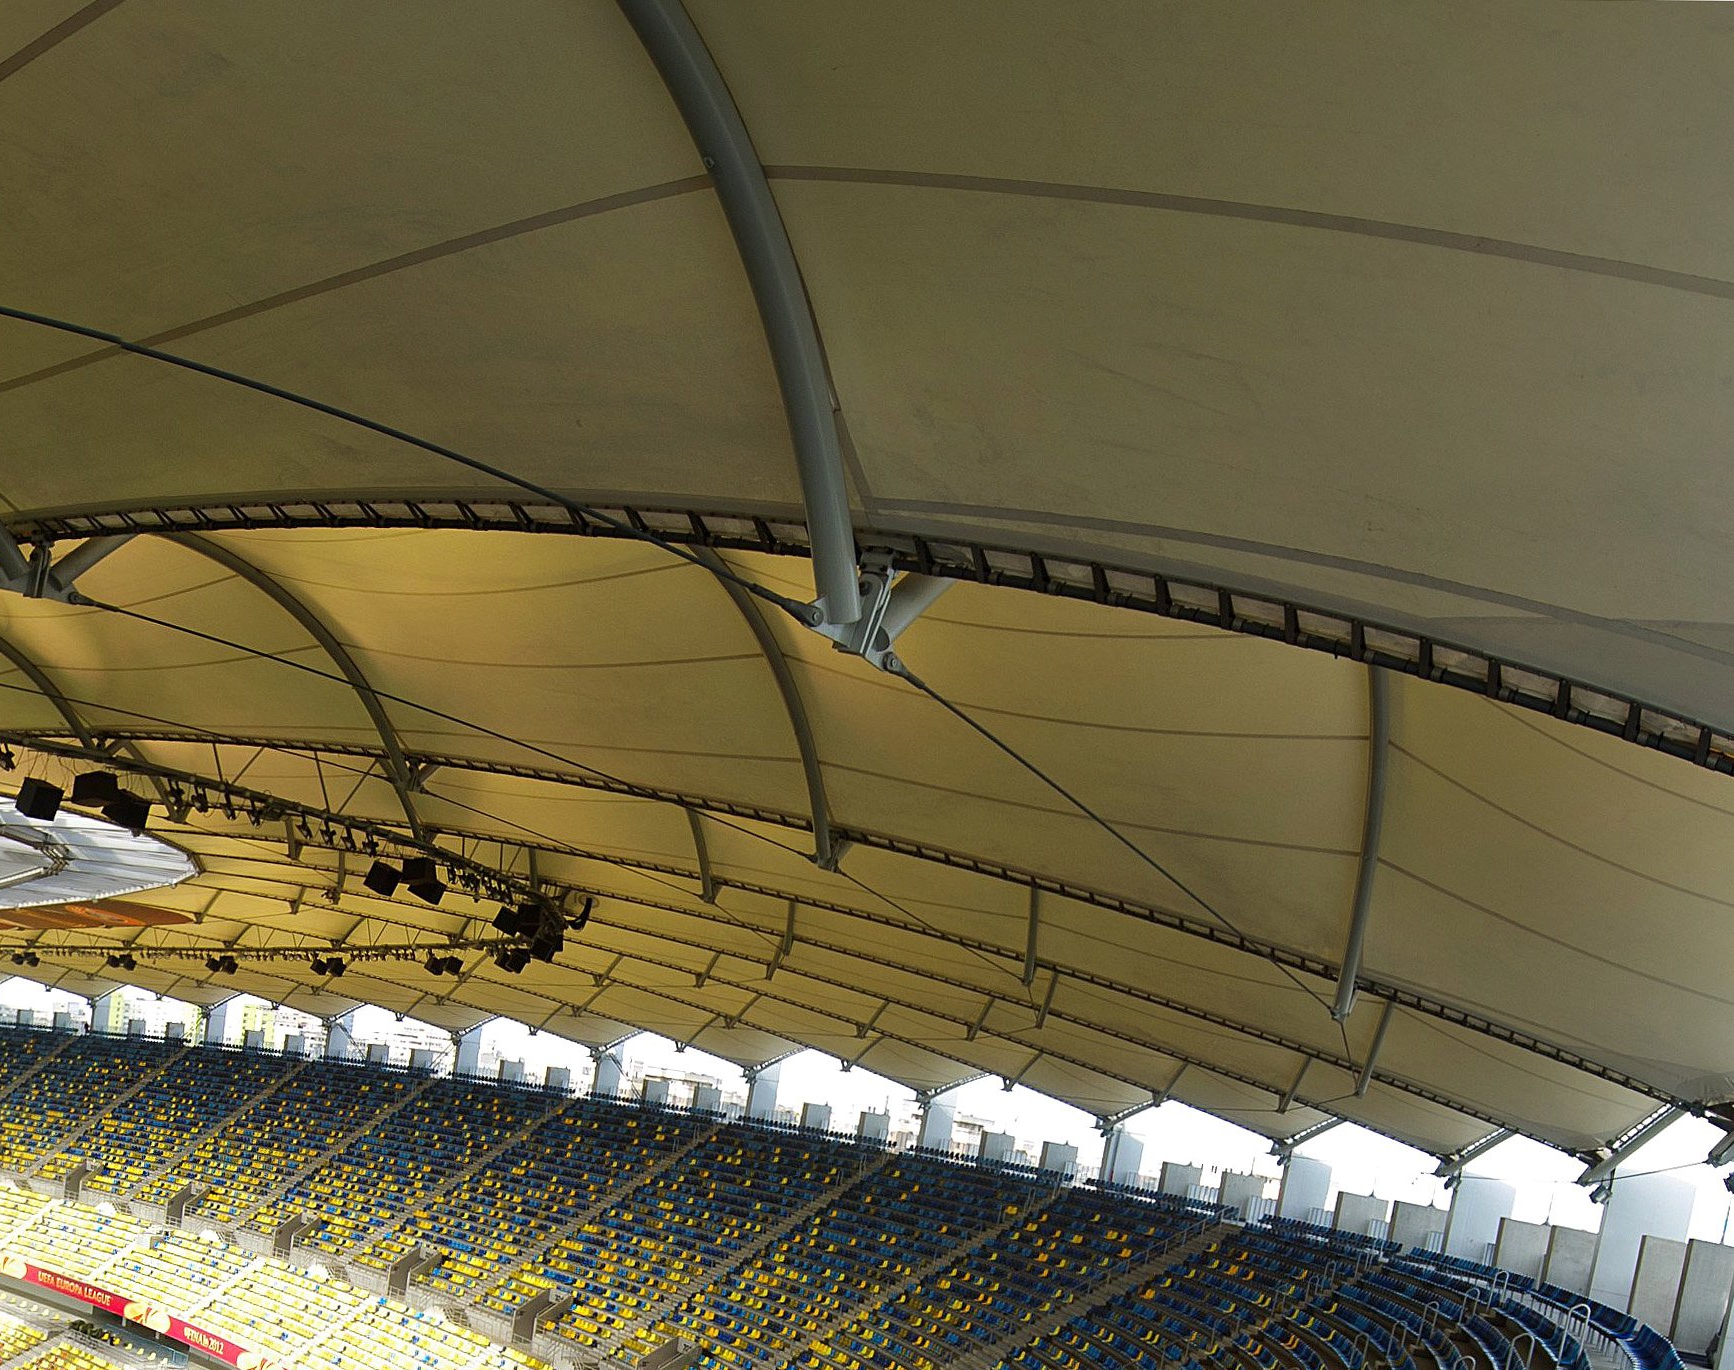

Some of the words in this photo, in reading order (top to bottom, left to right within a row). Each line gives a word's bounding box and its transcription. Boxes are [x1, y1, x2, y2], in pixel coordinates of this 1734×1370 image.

[38, 1271, 55, 1287] UEFA
[56, 1278, 83, 1295] EUROPA
[84, 1286, 111, 1306] LEAGUE
